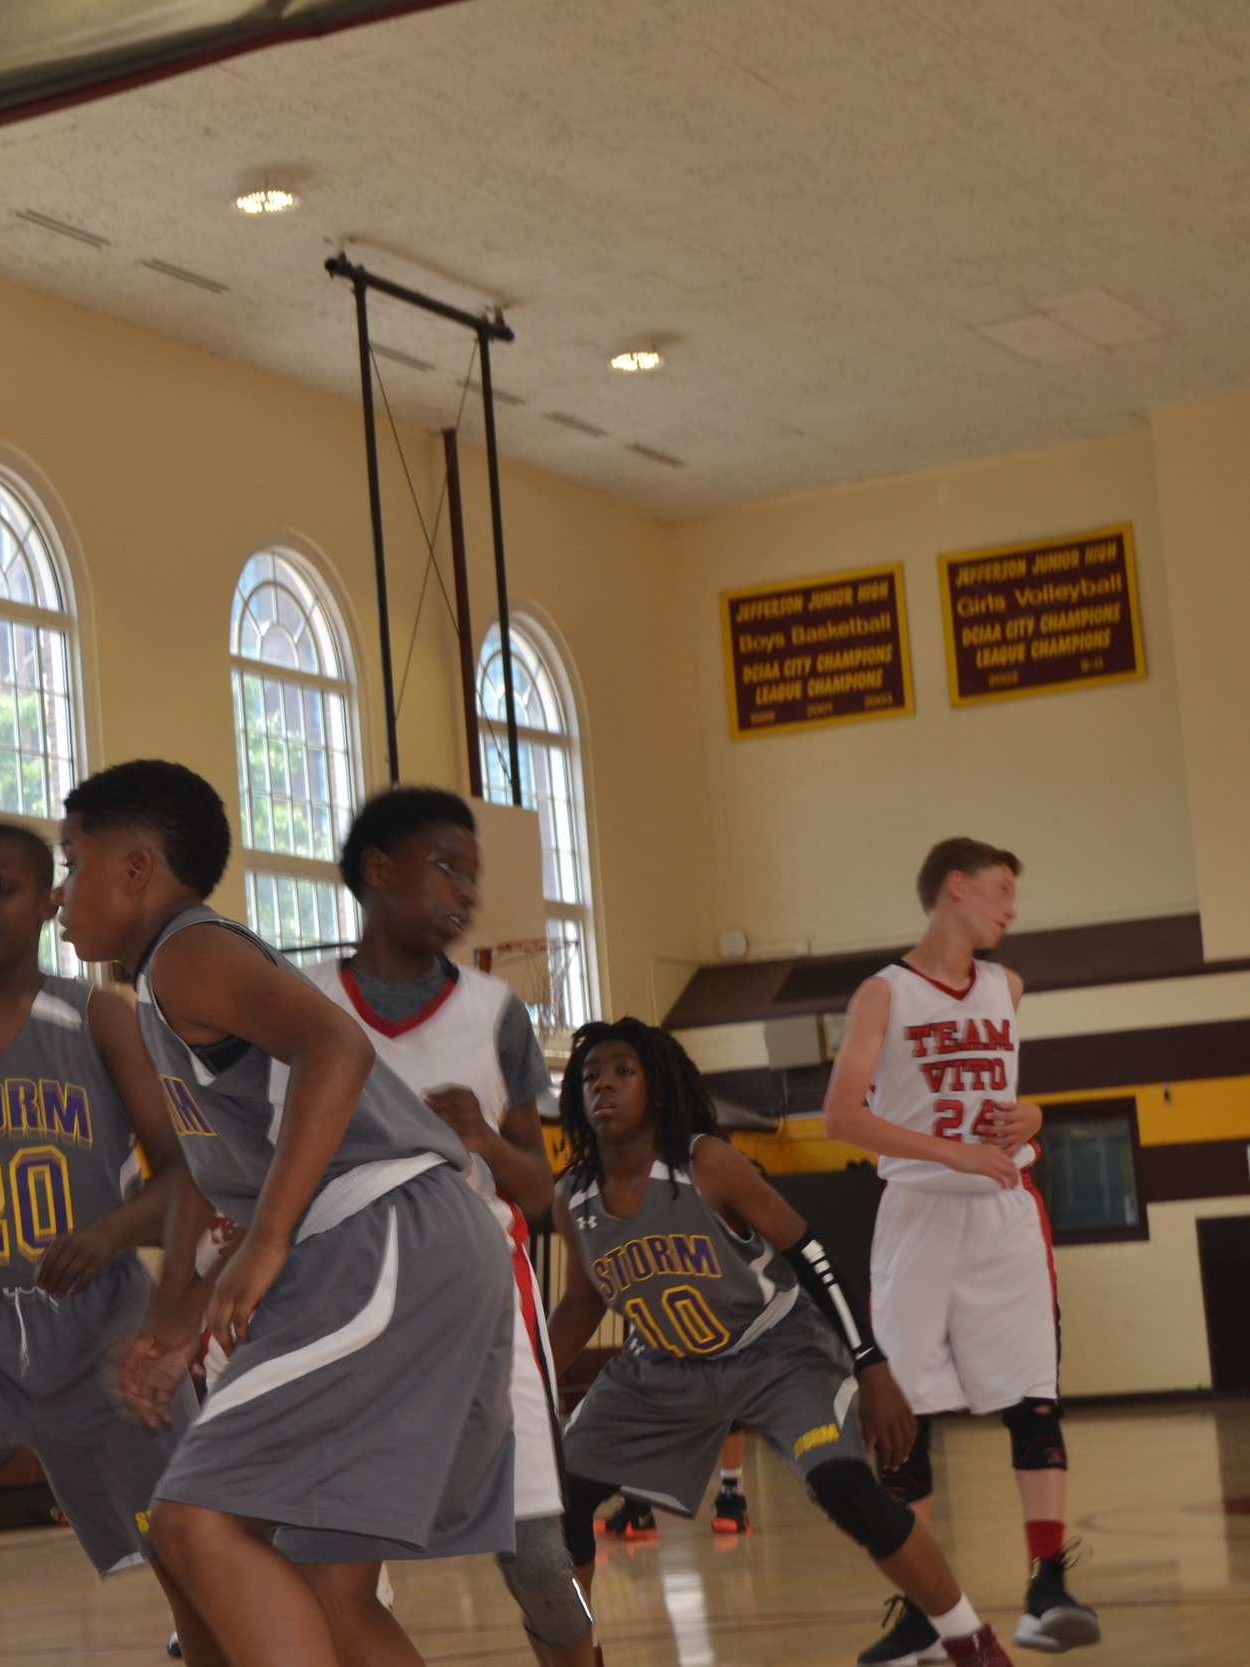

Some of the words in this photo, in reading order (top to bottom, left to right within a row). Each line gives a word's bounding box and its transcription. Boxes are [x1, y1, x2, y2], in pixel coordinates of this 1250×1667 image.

[955, 557, 1026, 588] JEFFERSON
[1031, 547, 1081, 576] JUNIOR
[1084, 540, 1118, 566] HIGH
[736, 593, 804, 625] JEFFERSON
[808, 585, 854, 613] JUNIOR
[857, 579, 889, 604] HIGH
[956, 591, 1006, 619] Girls
[1014, 571, 1123, 608] Volleyball
[738, 631, 786, 655] Boys
[791, 611, 892, 646] Basketball
[962, 621, 1002, 648] DCIAA
[1005, 615, 1036, 640] CITY
[1040, 601, 1121, 635] CHAMPIONS
[742, 660, 781, 685] DCIAA
[783, 655, 813, 679] CITY
[816, 642, 894, 675] CHAMPIONS
[975, 641, 1027, 669] LEAGUE
[1030, 627, 1112, 661] CHAMPIONS
[755, 680, 803, 706] LEAGUE
[807, 667, 884, 699] CHAMPIONS
[904, 1018, 1014, 1057] TEAM
[919, 1058, 1007, 1093] VITO
[591, 1234, 723, 1302] STORM
[625, 1284, 731, 1358] 10
